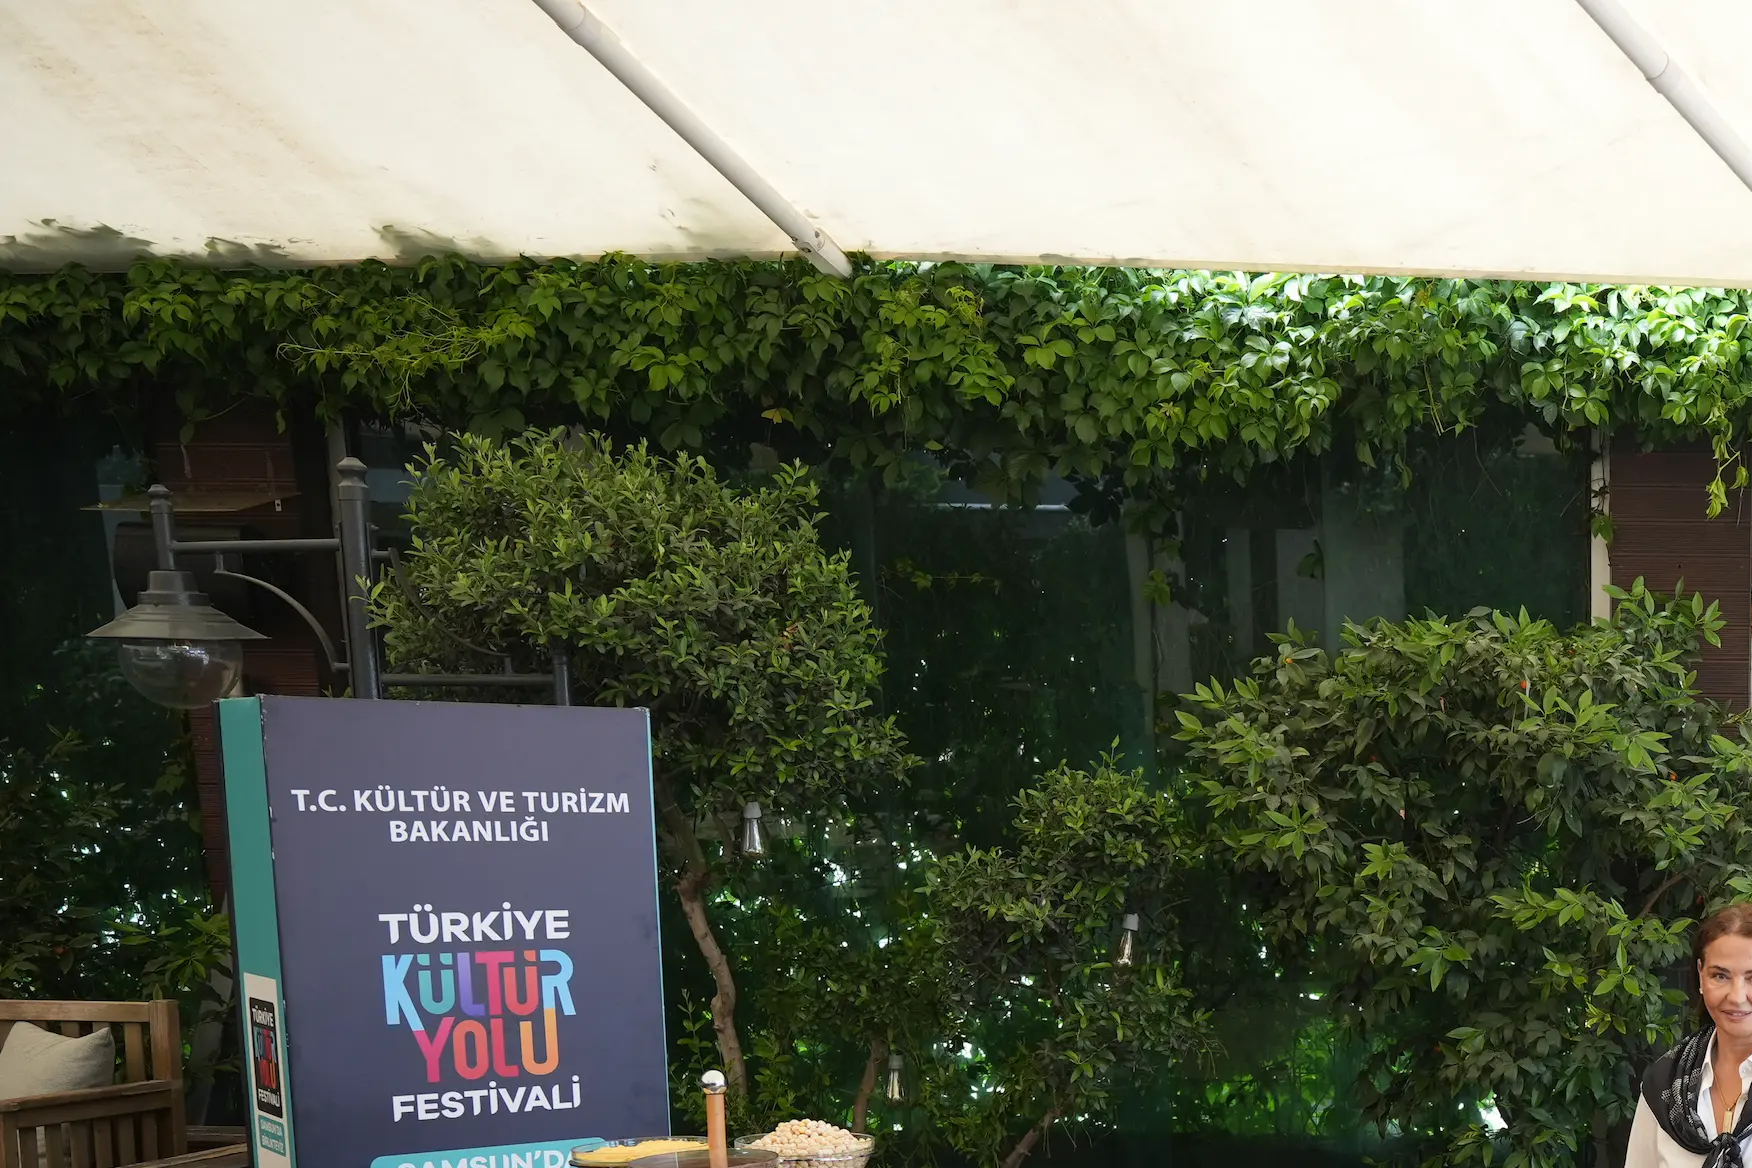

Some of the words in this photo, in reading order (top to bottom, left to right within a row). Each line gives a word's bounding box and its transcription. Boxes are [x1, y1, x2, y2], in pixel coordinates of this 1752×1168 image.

[290, 789, 347, 812] T.C.
[353, 784, 472, 813] KÜLTÜR
[477, 790, 516, 812] VE
[521, 787, 631, 813] TURİZM
[389, 816, 549, 843] BAKANLIĞI
[378, 901, 571, 945] TÜRKİYE
[381, 949, 577, 1032] KÜLTÜR
[412, 1008, 560, 1083] YOLU
[392, 1074, 582, 1122] FESTİVALİ
